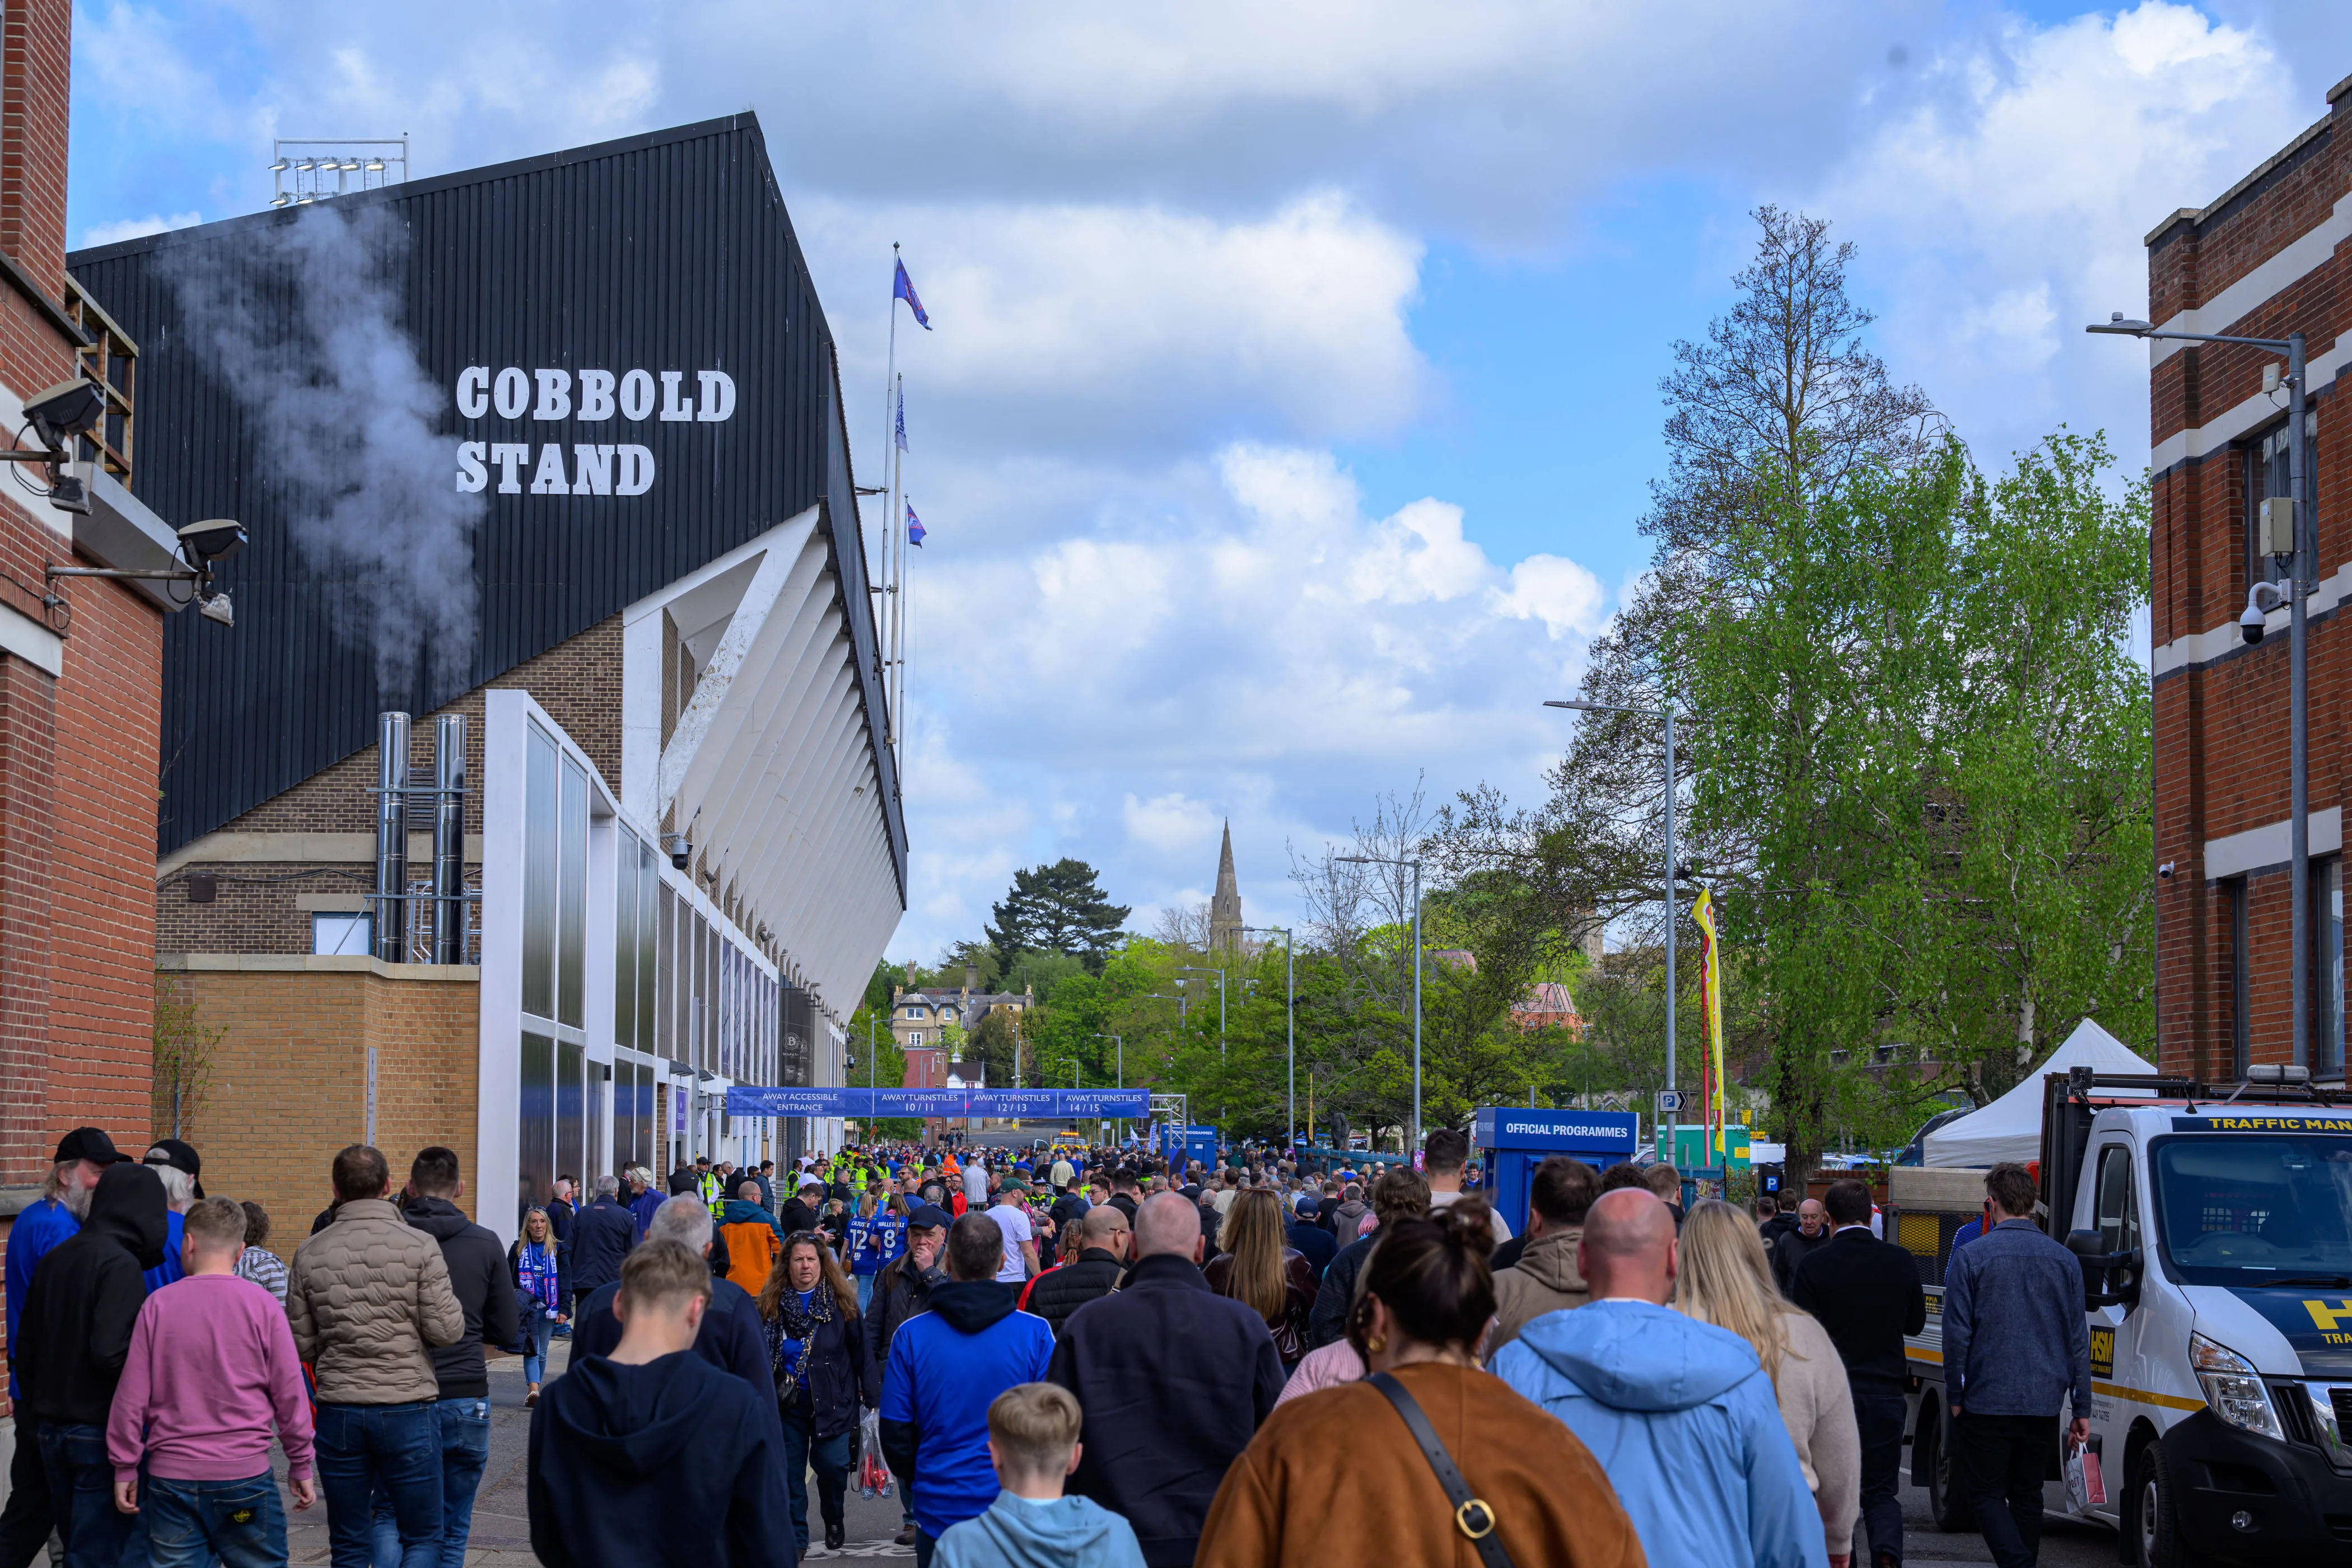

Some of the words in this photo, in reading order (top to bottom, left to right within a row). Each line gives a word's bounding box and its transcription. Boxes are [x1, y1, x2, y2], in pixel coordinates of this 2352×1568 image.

[457, 366, 736, 423] COBBOLD
[456, 441, 655, 496] STAND
[1506, 1123, 1551, 1135] OFFICIAL
[1553, 1125, 1627, 1137] PROGRAMMES
[2209, 1118, 2300, 1128] TRAFFIC
[850, 1229, 867, 1249] 12
[884, 1229, 895, 1248] 8
[2090, 1331, 2113, 1362] HSM
